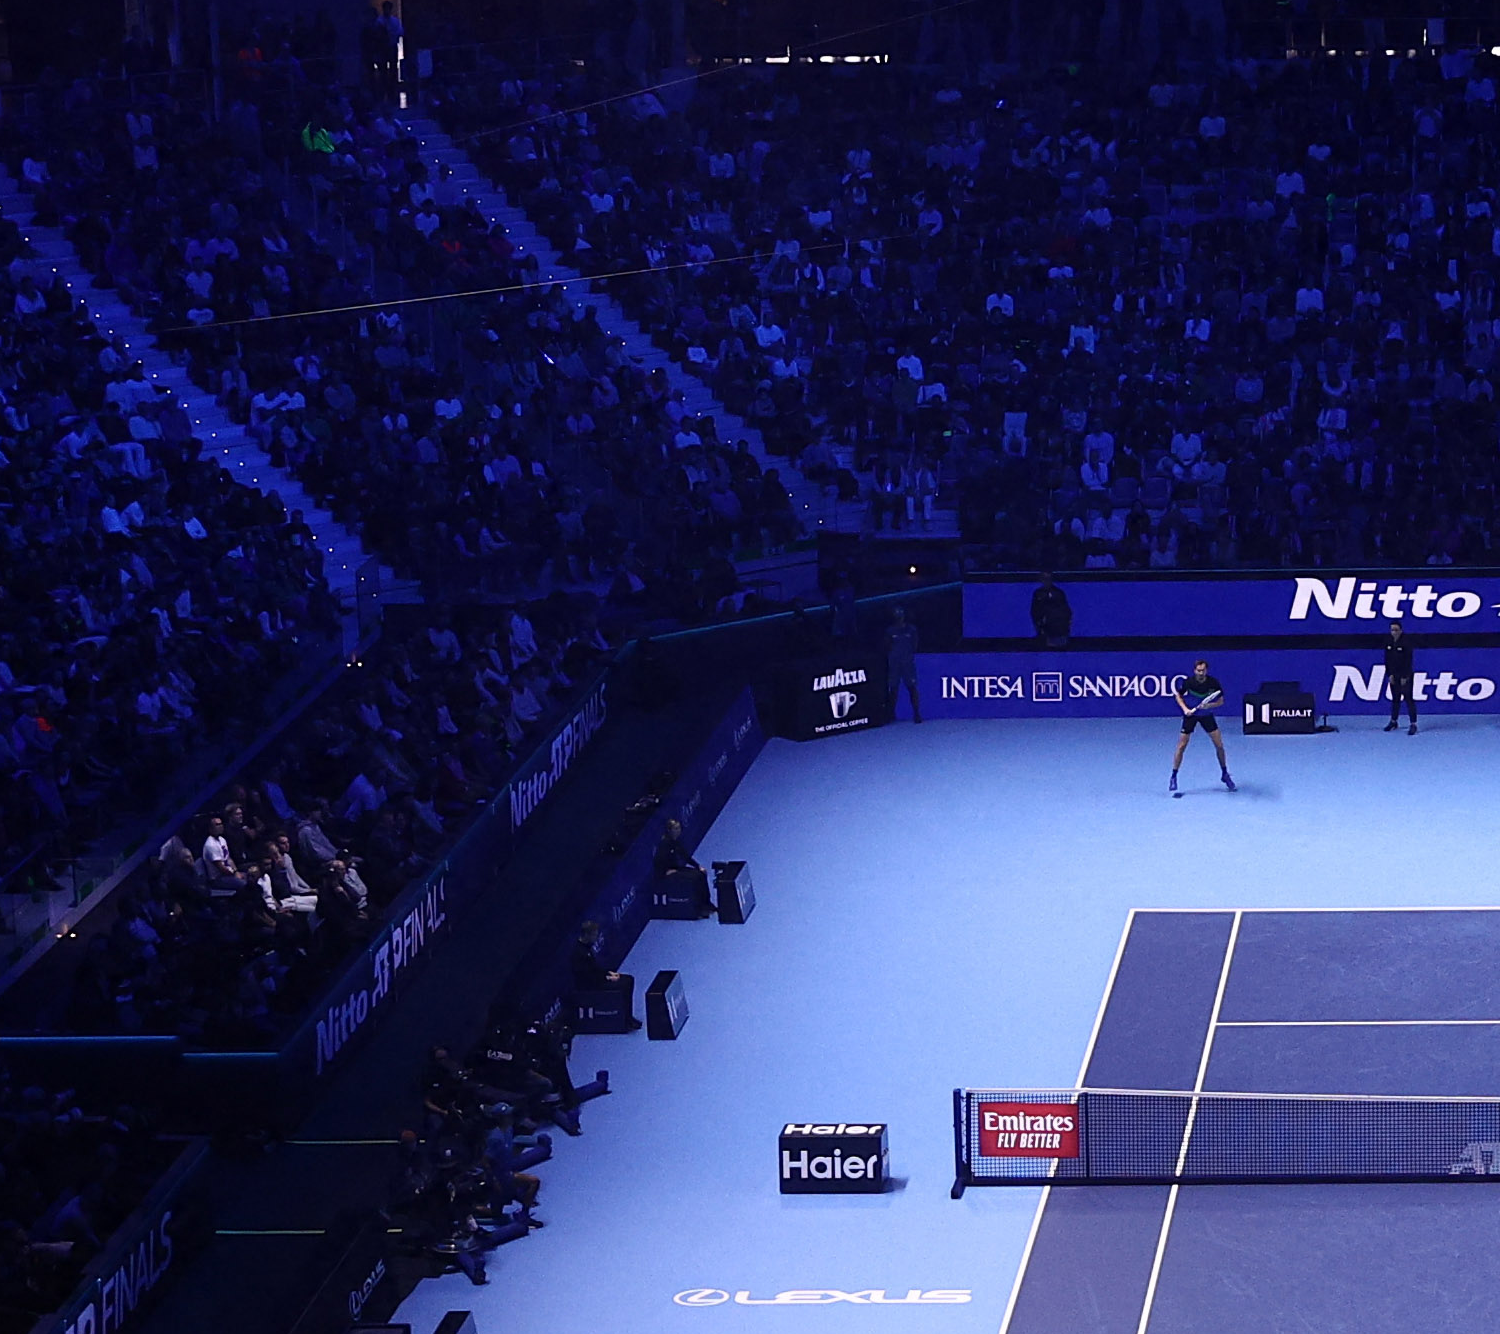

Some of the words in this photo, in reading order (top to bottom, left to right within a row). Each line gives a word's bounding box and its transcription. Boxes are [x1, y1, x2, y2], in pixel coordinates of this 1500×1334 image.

[1289, 576, 1482, 620] Nitto
[813, 668, 867, 691] LAVAZZA
[941, 675, 1026, 700] INTESA
[1329, 664, 1496, 703] Ntto
[1272, 708, 1312, 718] ITALIA.IT
[509, 766, 550, 832] Nitto
[315, 986, 369, 1073] Nitto
[784, 1123, 883, 1135] Haier
[983, 1110, 1074, 1134] Emirates
[997, 1133, 1018, 1150] FLY
[1019, 1132, 1062, 1150] BETTER
[782, 1148, 878, 1181] Haier
[734, 1288, 973, 1306] LEXUS
